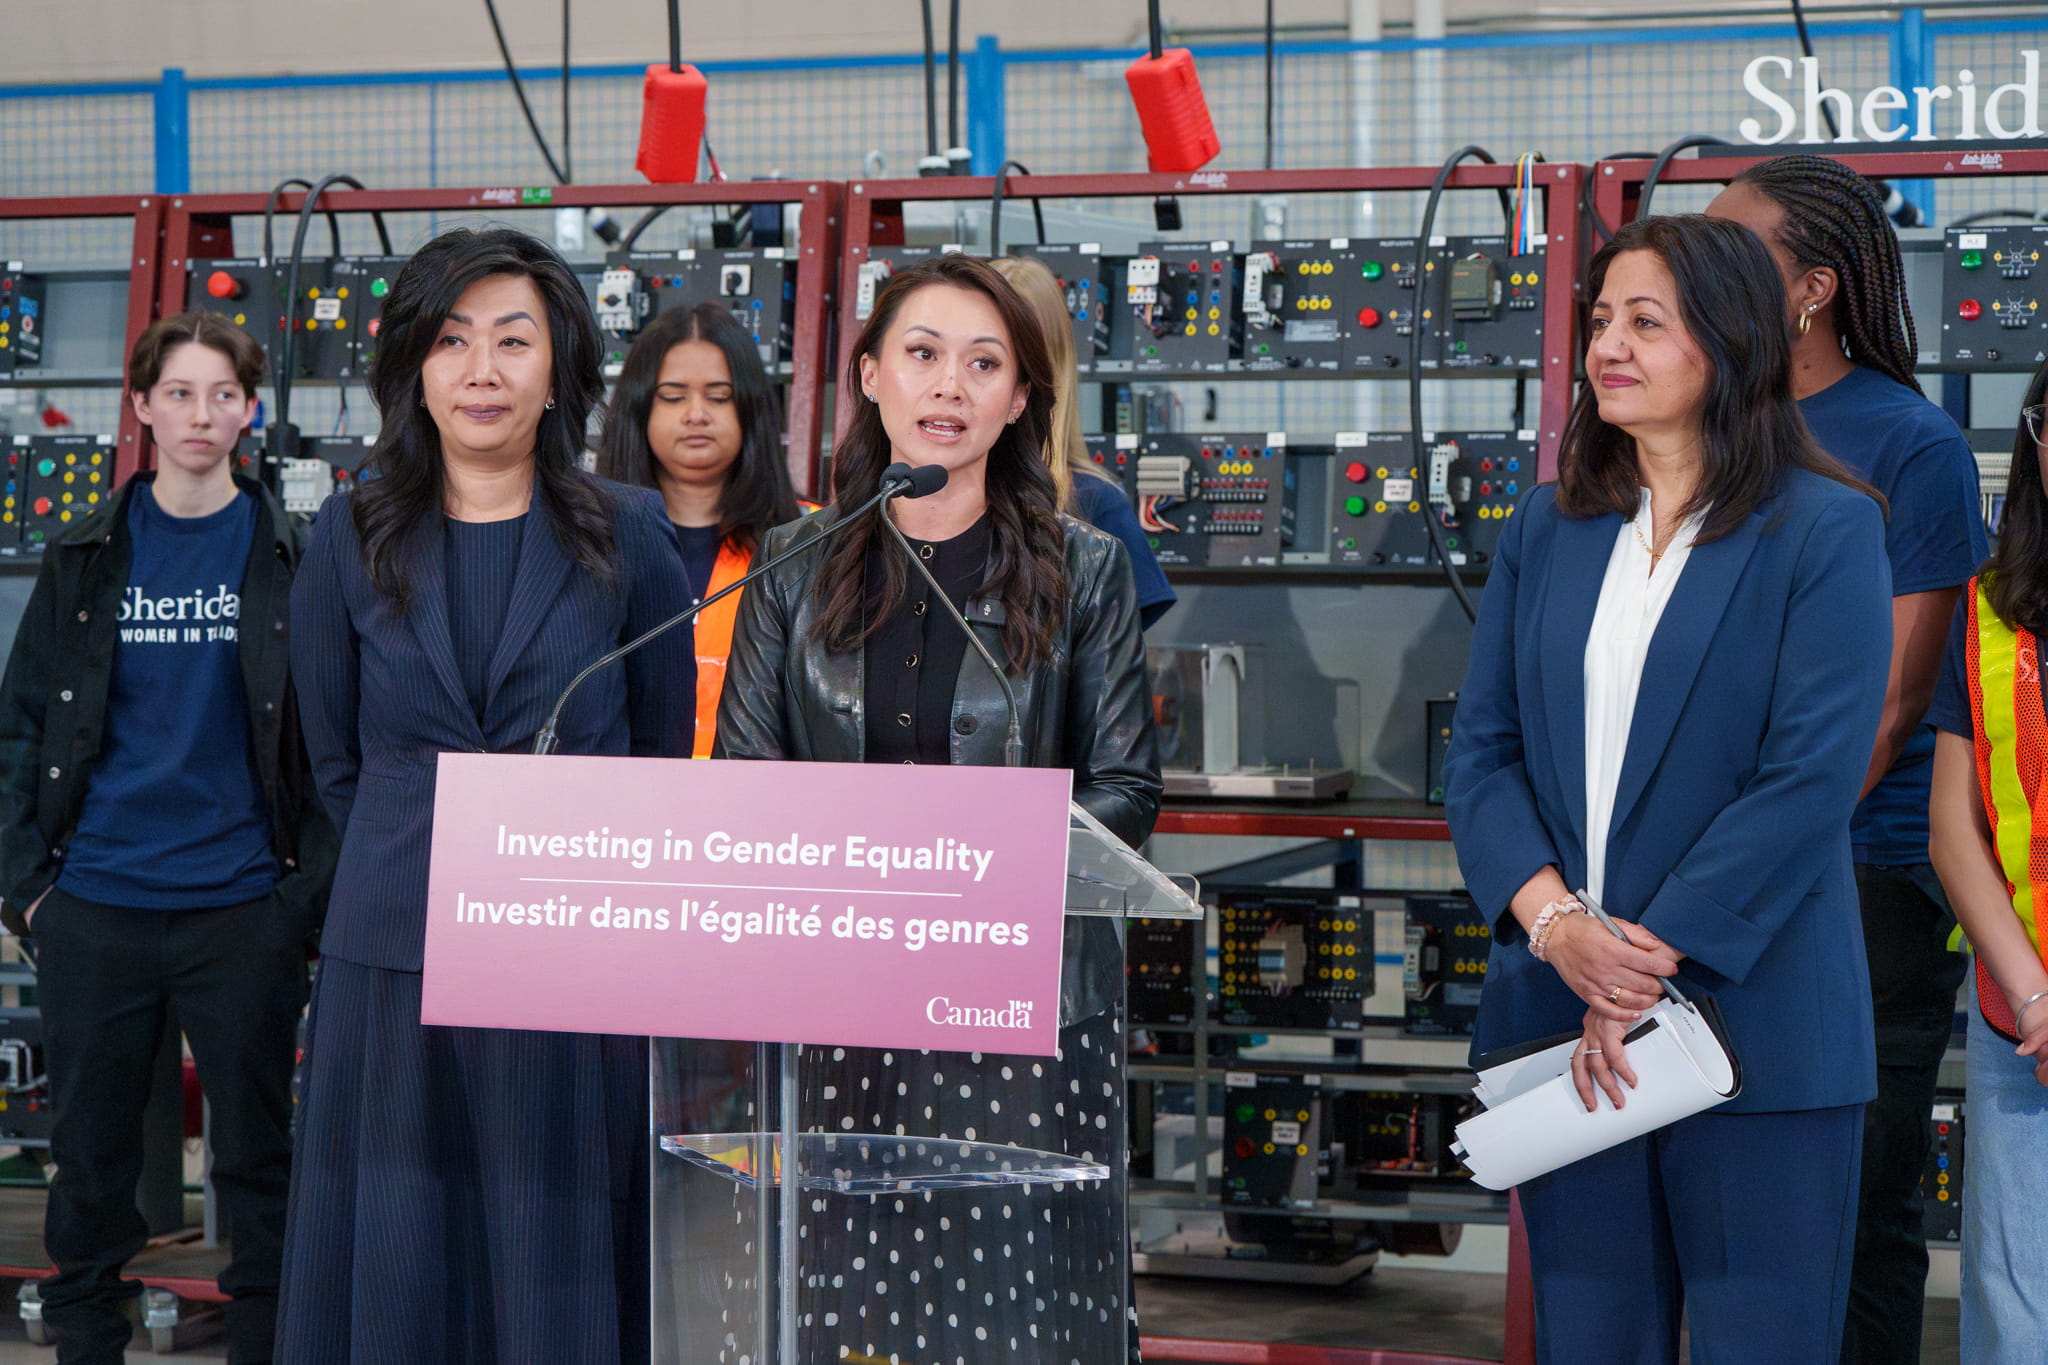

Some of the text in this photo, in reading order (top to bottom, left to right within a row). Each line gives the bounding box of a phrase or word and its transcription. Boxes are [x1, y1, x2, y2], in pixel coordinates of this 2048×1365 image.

[1739, 50, 2045, 146] Sherid
[120, 627, 177, 643] WOMEN
[183, 627, 201, 643] IN
[497, 825, 995, 882] Investing in Gender Equality
[456, 892, 1030, 952] Investir dans l'égalité des genres
[926, 996, 1033, 1029] Canada
